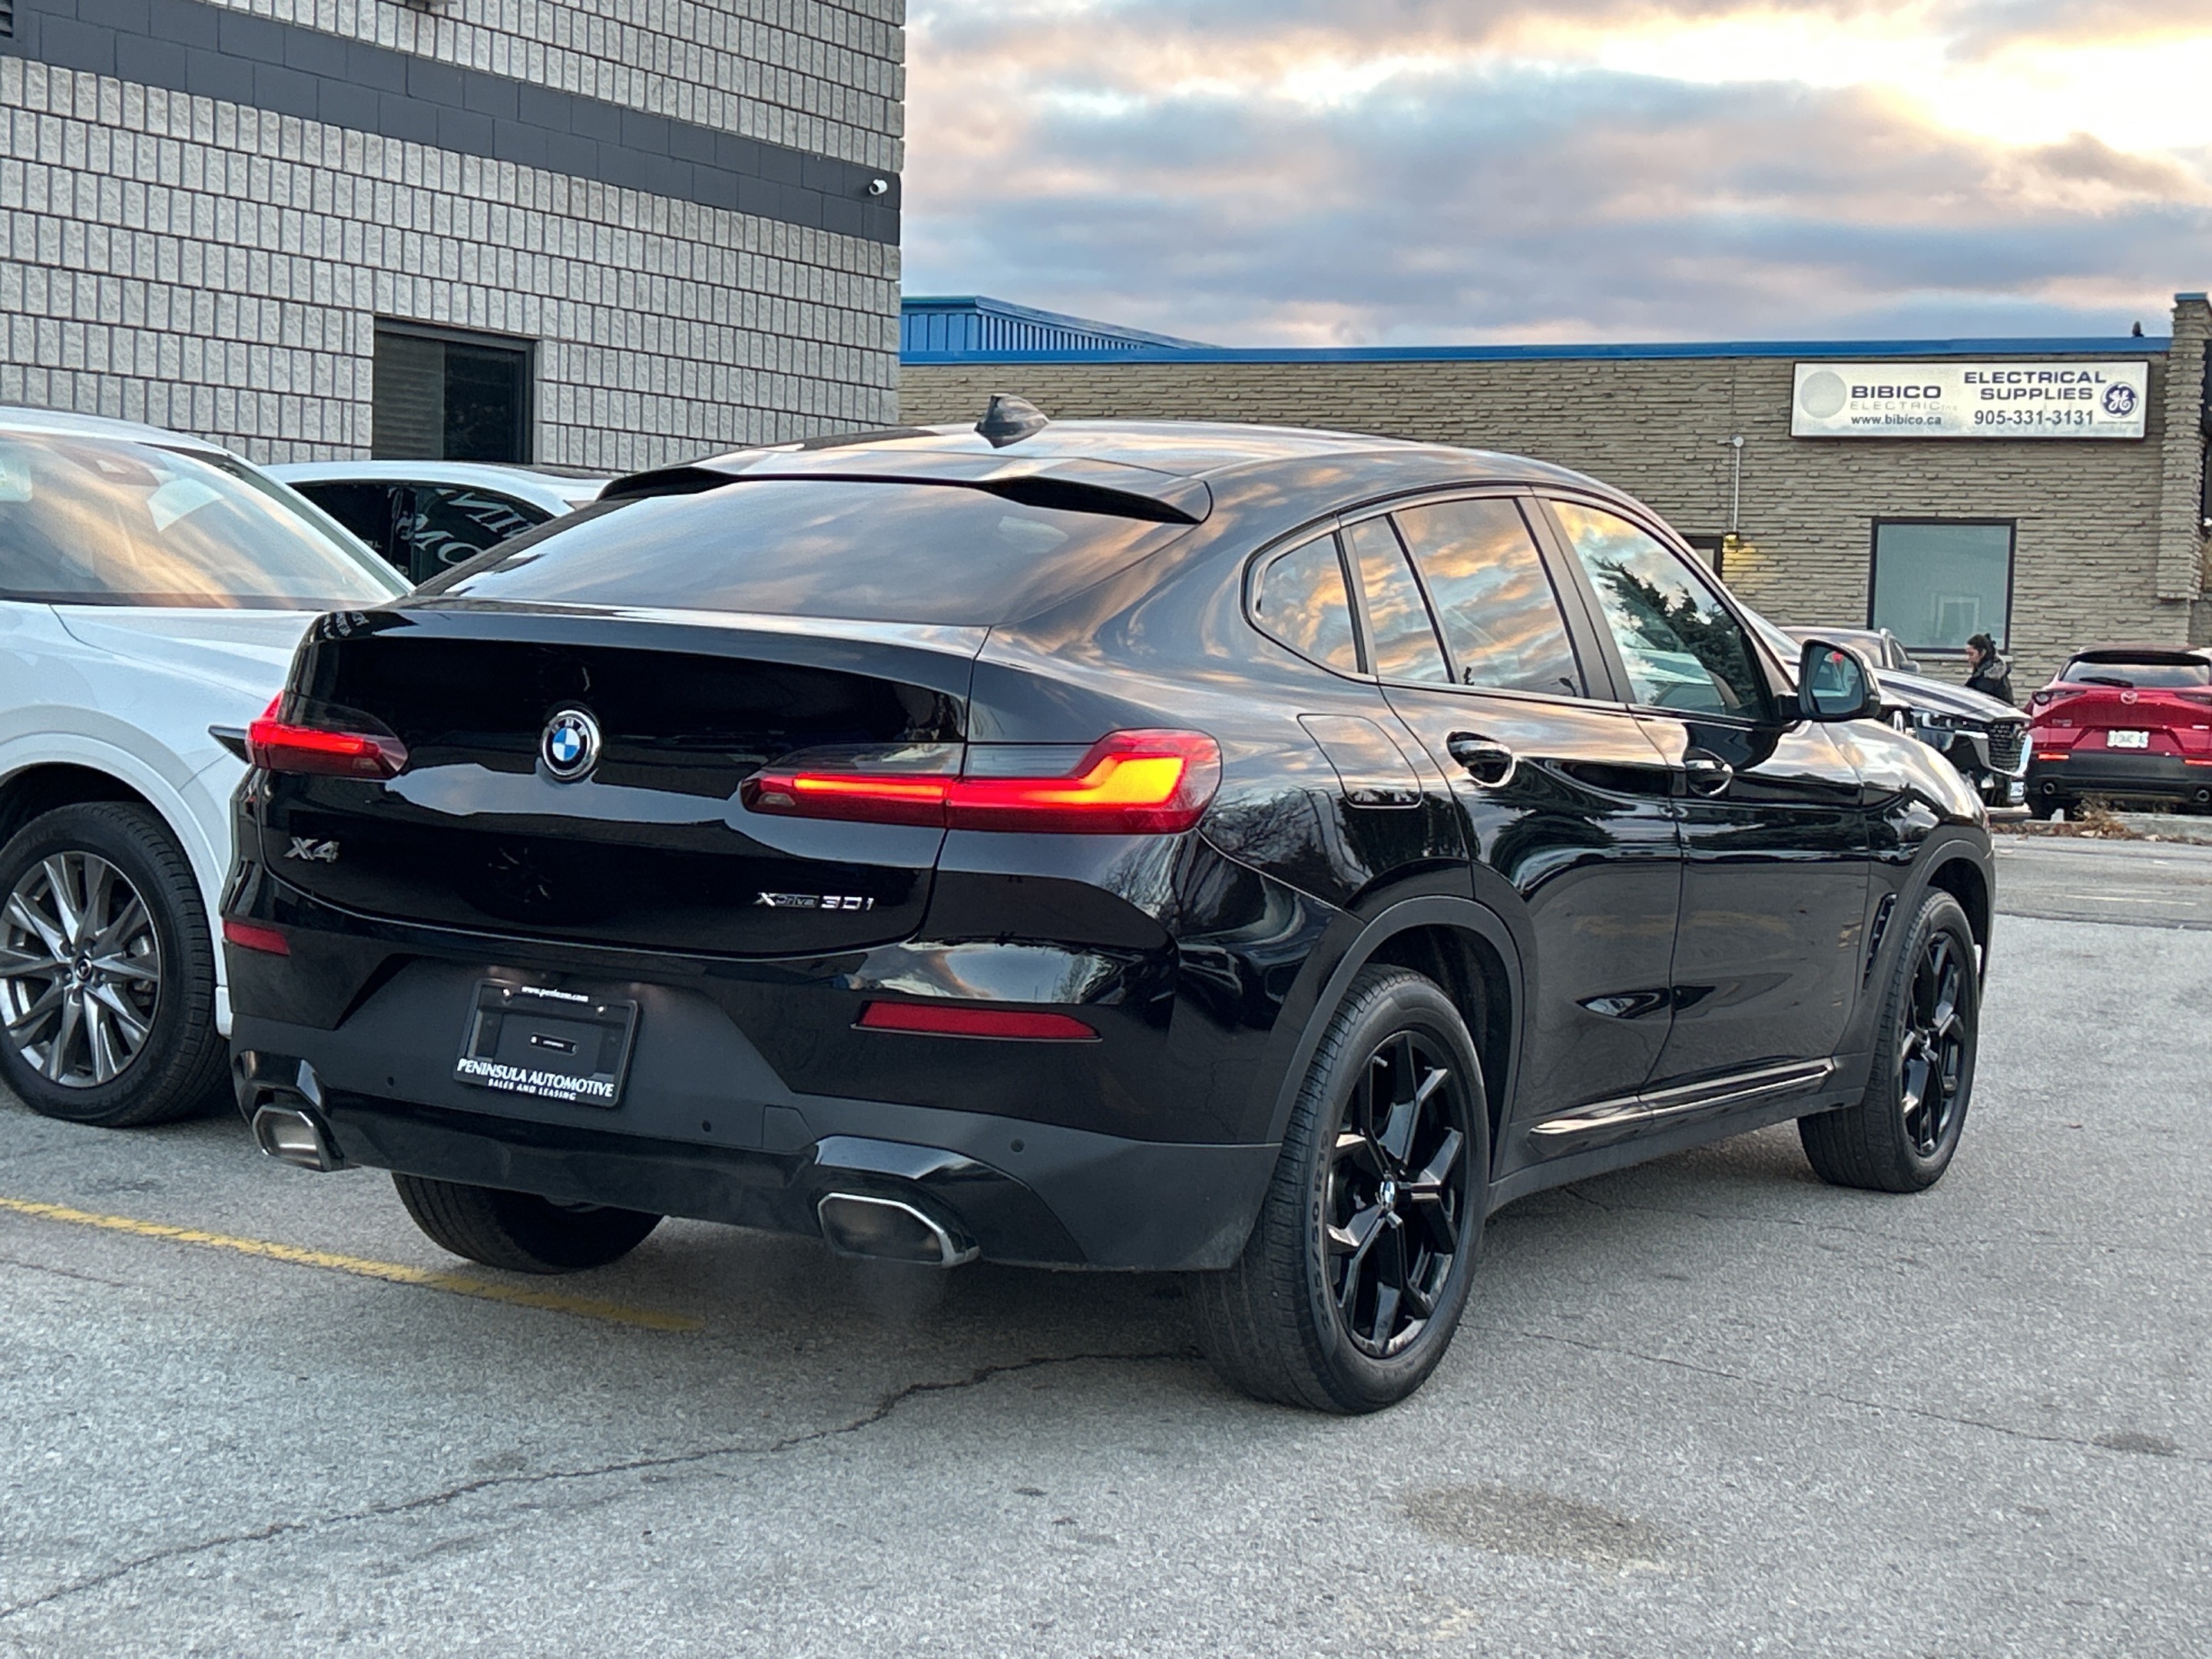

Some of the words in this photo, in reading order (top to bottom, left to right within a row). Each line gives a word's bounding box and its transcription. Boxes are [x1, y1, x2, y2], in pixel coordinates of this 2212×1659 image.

[1964, 371, 2107, 384] ELECTRICAL
[1851, 386, 1942, 399] BIBICO
[1981, 387, 2093, 400] SUPPLIES
[1851, 414, 1942, 425] www.bibico.ca
[1974, 409, 2093, 425] 905-331-3131
[283, 836, 339, 863] X4
[457, 1058, 526, 1083] PENINSULA
[528, 1070, 614, 1098] AUTOMOTIVE
[488, 1078, 515, 1090] SALES
[516, 1083, 536, 1094] AND
[538, 1087, 576, 1101] LEASING
